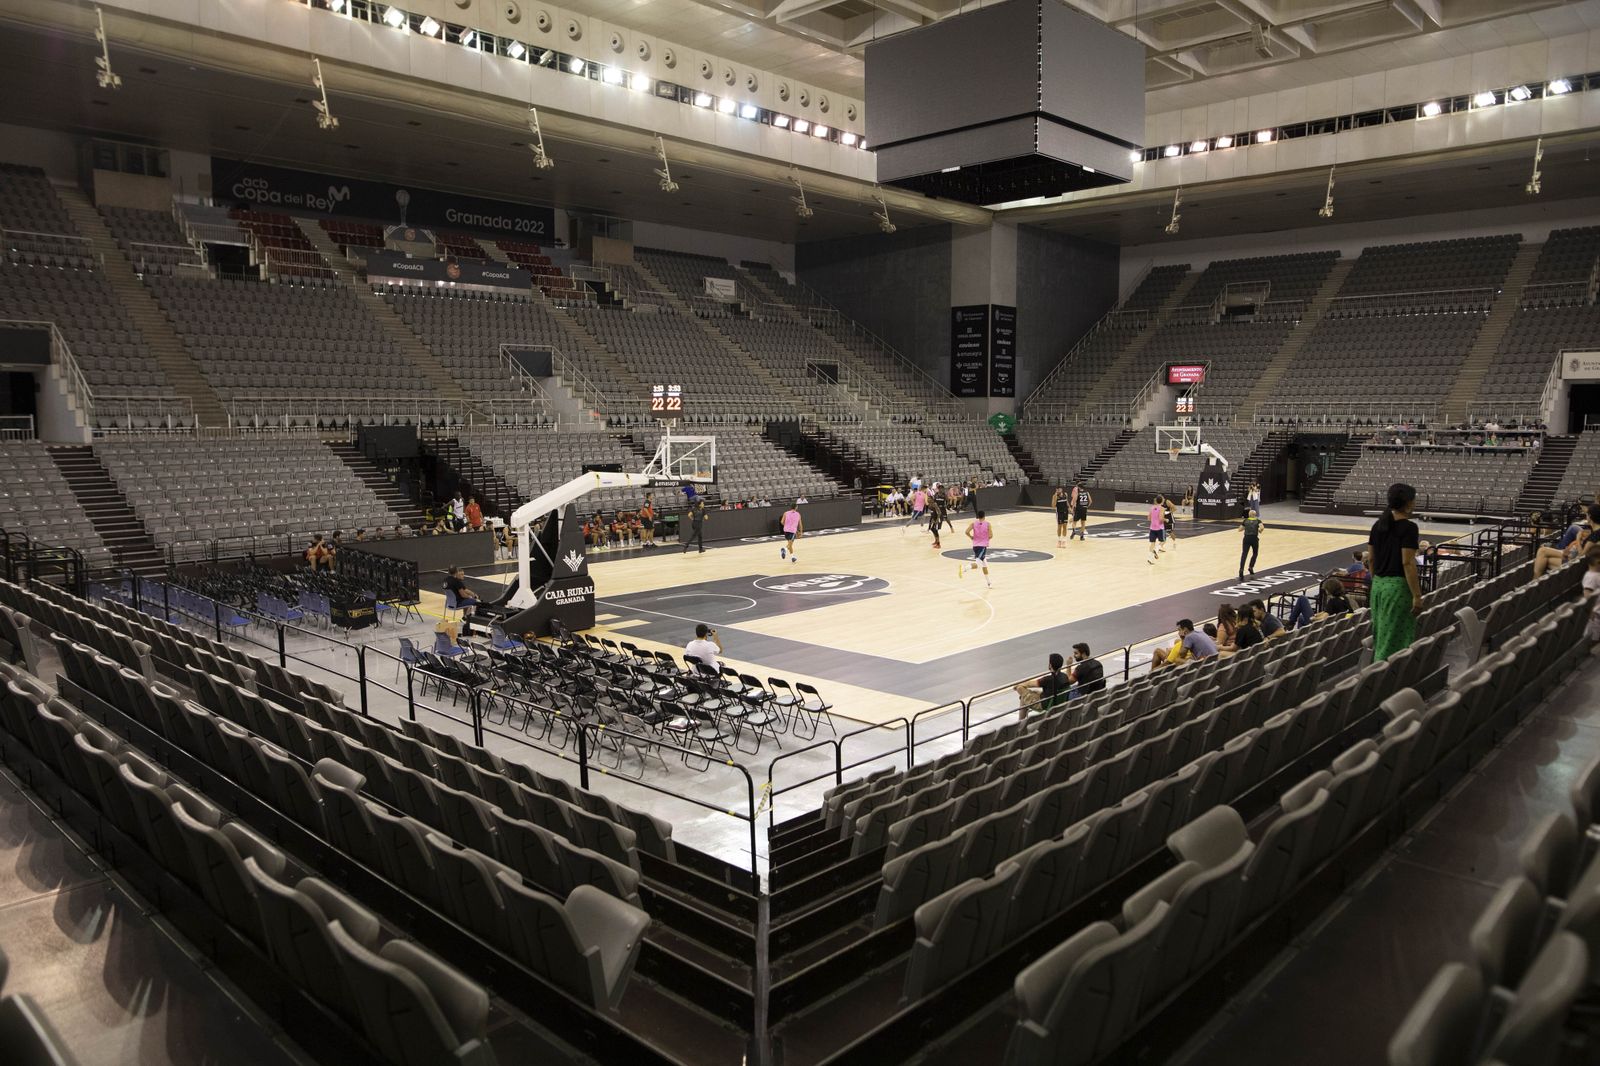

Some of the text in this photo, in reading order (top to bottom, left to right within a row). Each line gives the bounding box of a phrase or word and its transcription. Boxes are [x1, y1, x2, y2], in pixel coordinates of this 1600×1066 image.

[242, 176, 269, 189] acb
[232, 183, 335, 214] Copa del Rey
[445, 208, 545, 234] Granada 2022
[652, 397, 681, 411] 22 22
[1175, 404, 1187, 412] 22
[545, 585, 595, 601] CAJA RURAL
[555, 595, 586, 606] GRANADA
